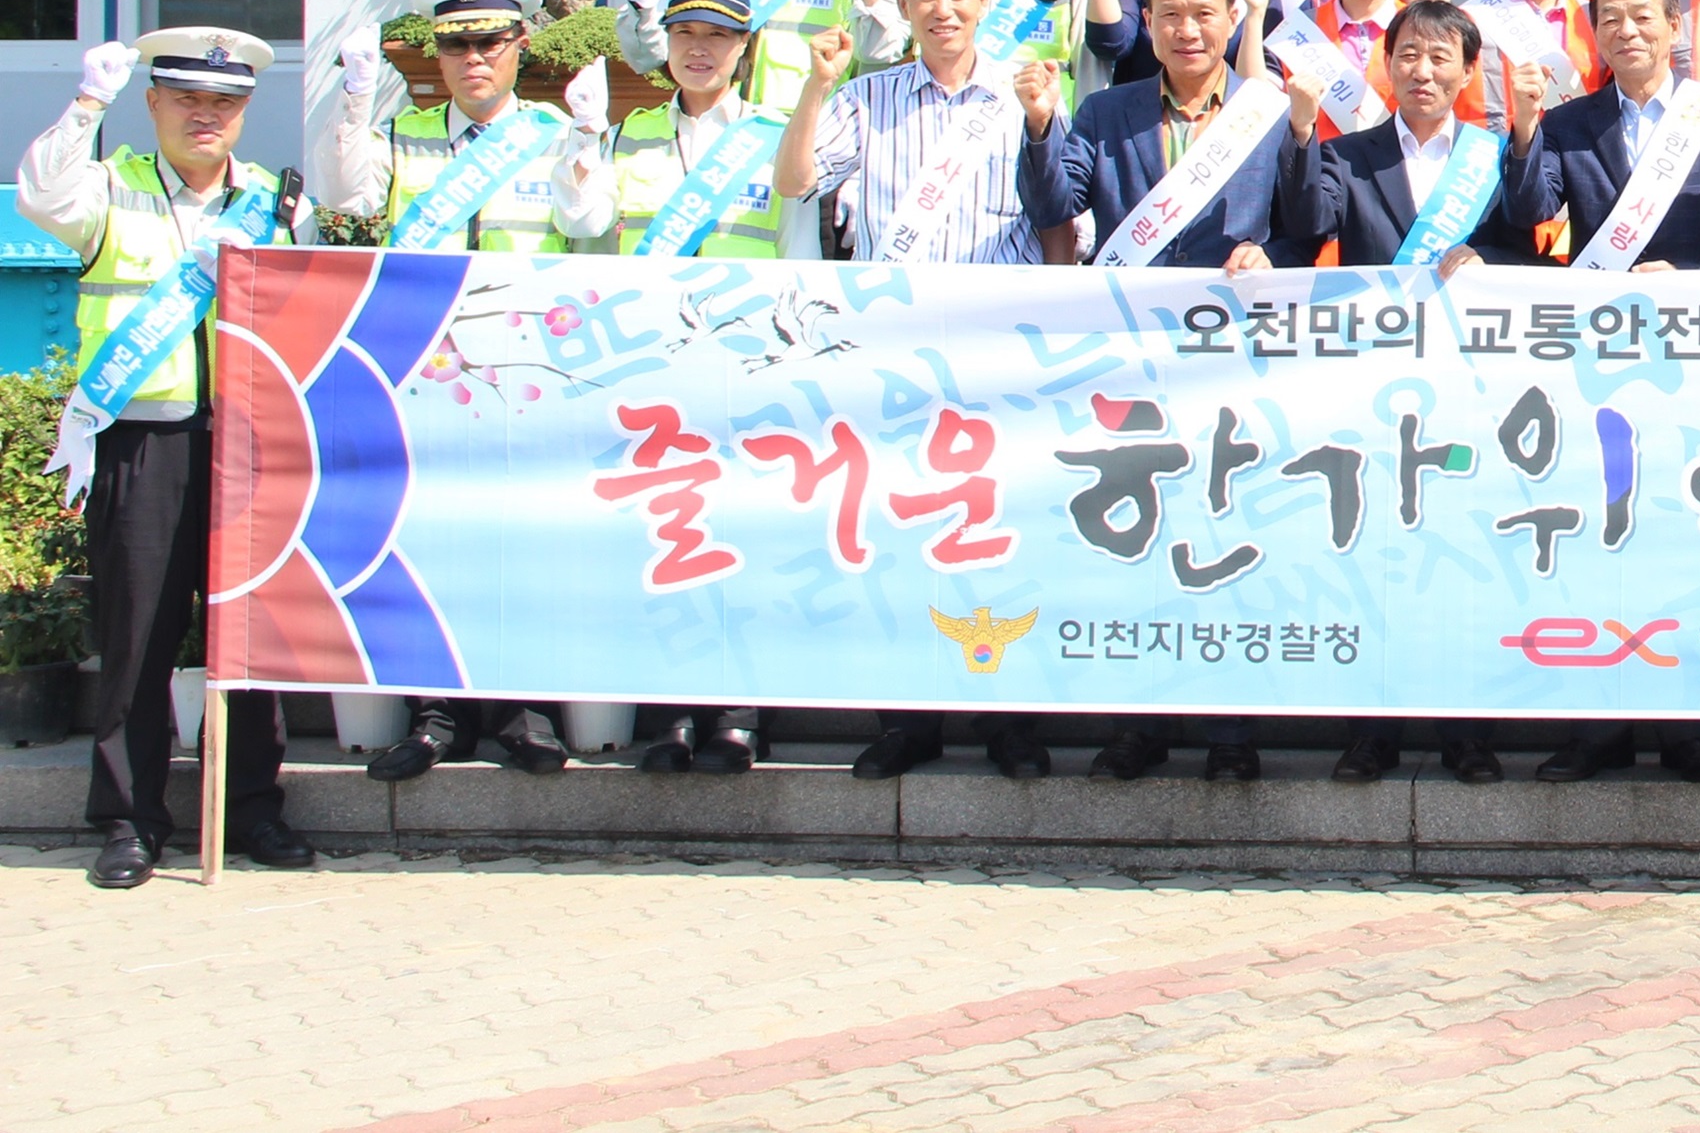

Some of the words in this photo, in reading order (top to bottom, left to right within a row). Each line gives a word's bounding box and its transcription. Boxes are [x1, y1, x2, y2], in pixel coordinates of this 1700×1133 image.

[961, 93, 1006, 142] 한우
[1187, 137, 1233, 187] 한우
[1650, 131, 1690, 181] 한우
[917, 157, 963, 211] 사랑
[1130, 196, 1183, 247] 사랑
[1609, 196, 1656, 252] 사랑
[1177, 301, 1427, 360] 오천만의
[90, 343, 143, 405] 만들기
[592, 403, 1018, 587] 즐거운
[1055, 385, 1638, 590] 한가위
[1058, 617, 1362, 666] 인천지방경찰청
[1499, 617, 1680, 668] ex
